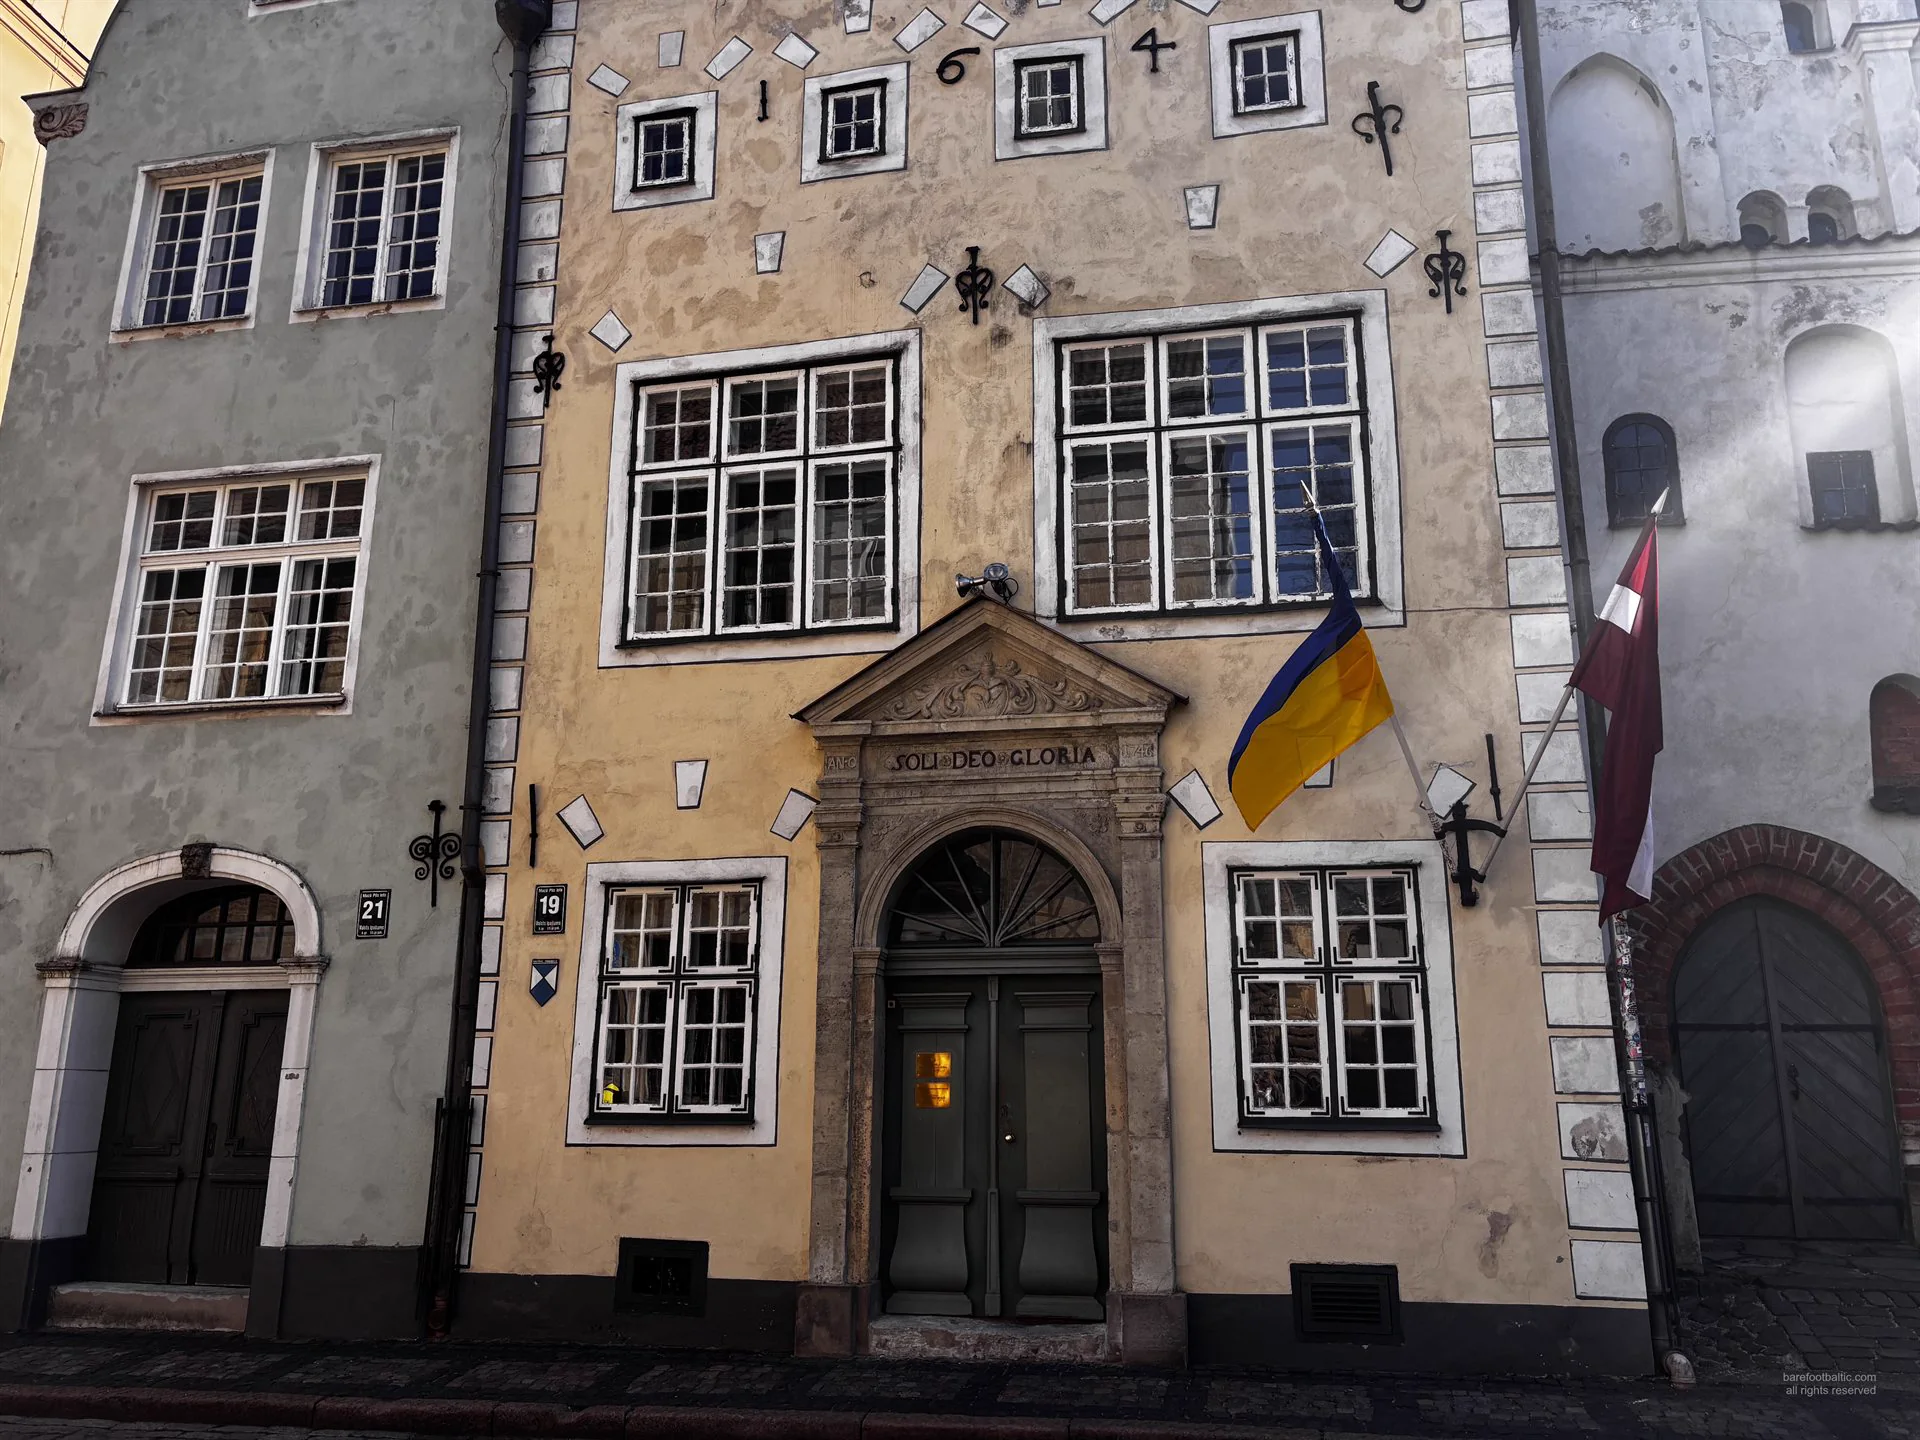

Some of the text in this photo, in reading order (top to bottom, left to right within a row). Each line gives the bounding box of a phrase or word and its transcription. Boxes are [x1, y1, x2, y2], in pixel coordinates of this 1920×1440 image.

[891, 746, 1096, 771] SOLI DEO GLORIA
[362, 900, 383, 919] 21
[540, 895, 560, 915] 19
